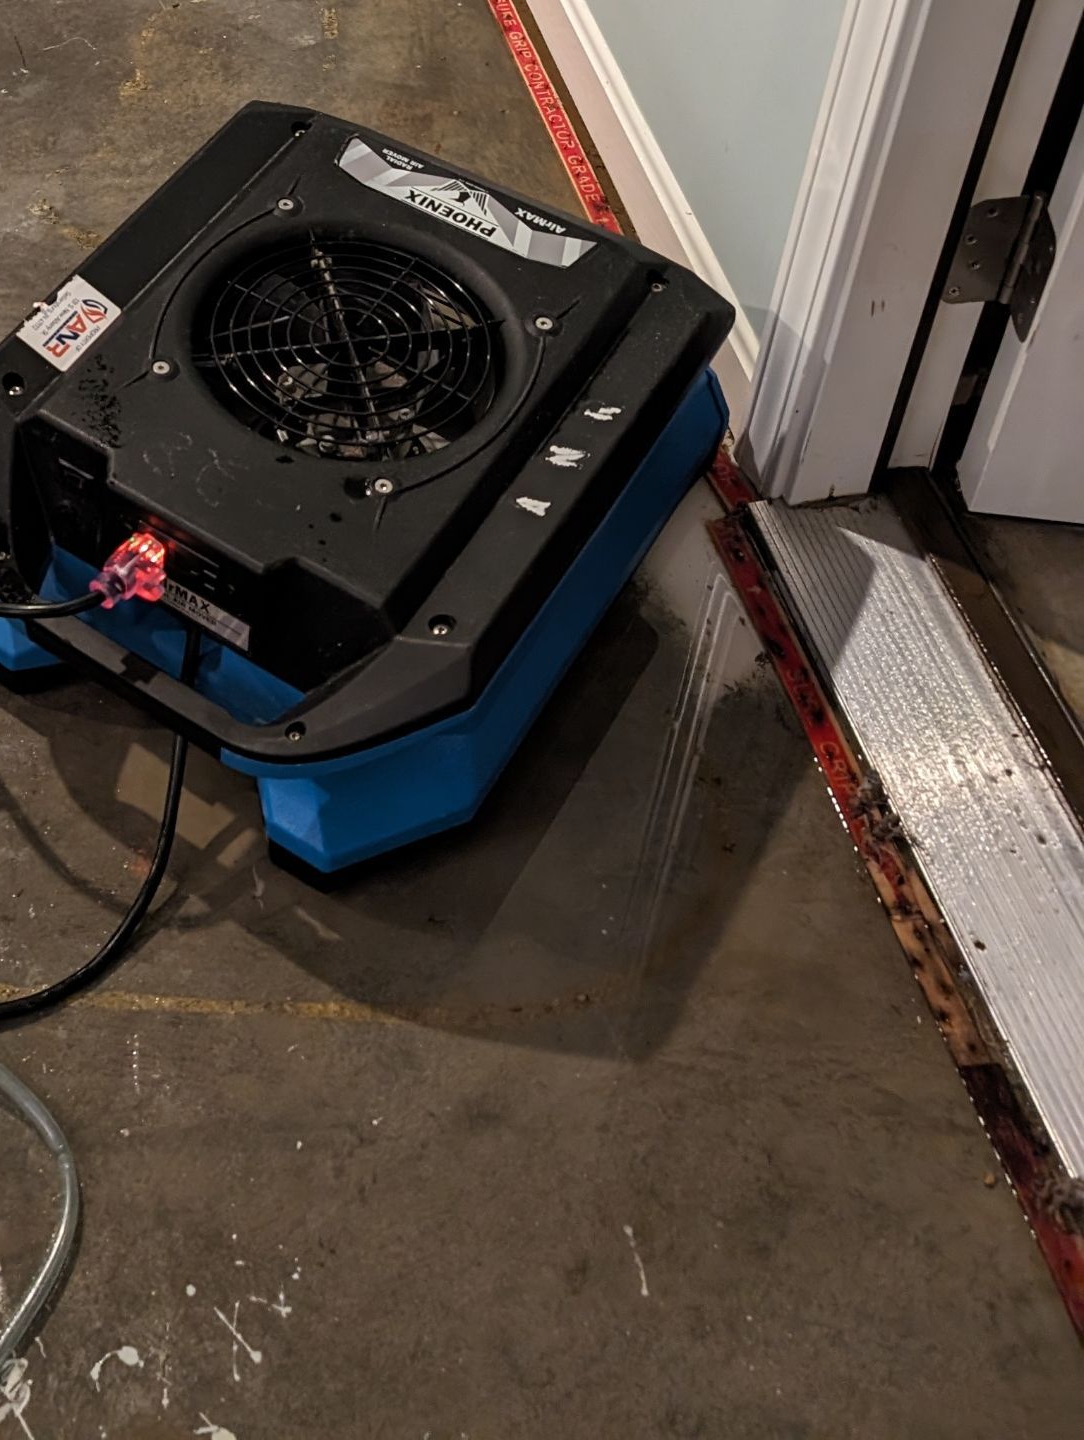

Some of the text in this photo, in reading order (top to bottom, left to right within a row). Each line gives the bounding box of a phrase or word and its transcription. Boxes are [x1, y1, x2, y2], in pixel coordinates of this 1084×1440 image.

[508, 31, 532, 59] GRIP
[524, 62, 576, 151] CONTRACTOR
[567, 155, 600, 202] GRADE
[381, 147, 425, 170] AIR MOVER
[384, 153, 415, 172] RADIAL
[406, 189, 498, 238] PHOENIX
[45, 314, 88, 358] ANR
